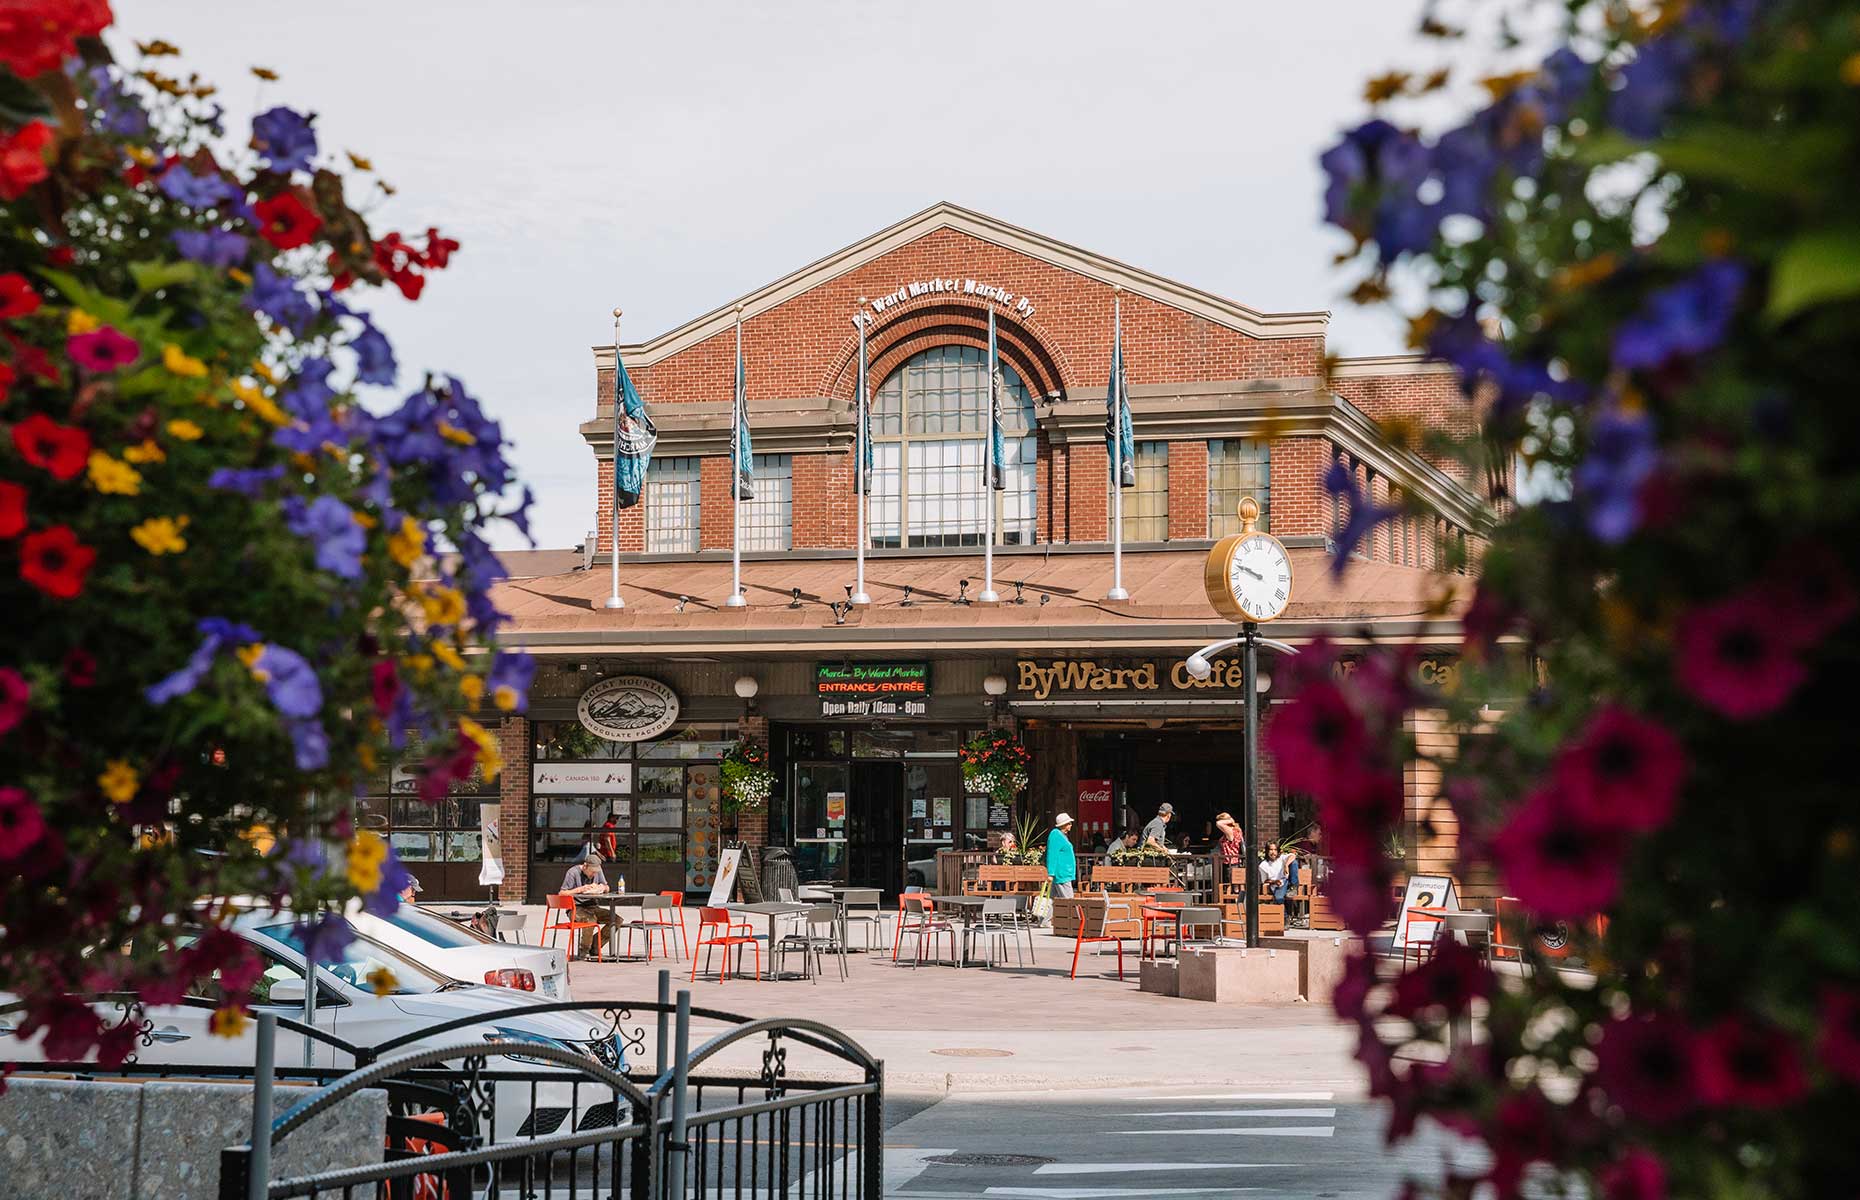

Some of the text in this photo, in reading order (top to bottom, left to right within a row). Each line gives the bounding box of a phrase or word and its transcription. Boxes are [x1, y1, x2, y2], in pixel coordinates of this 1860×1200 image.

[851, 277, 1035, 329] By Ward Market Marché By
[853, 667, 866, 680] By
[868, 667, 892, 678] Ward
[892, 667, 924, 678] Market
[1017, 660, 1159, 700] ByWard
[583, 679, 673, 702] ROCKY MOUNTAIN
[822, 701, 845, 716] Open
[847, 701, 870, 716] Daily
[872, 701, 896, 714] 10am
[904, 701, 925, 716] 8pm
[583, 716, 671, 738] CHOCOLATE FACTORY
